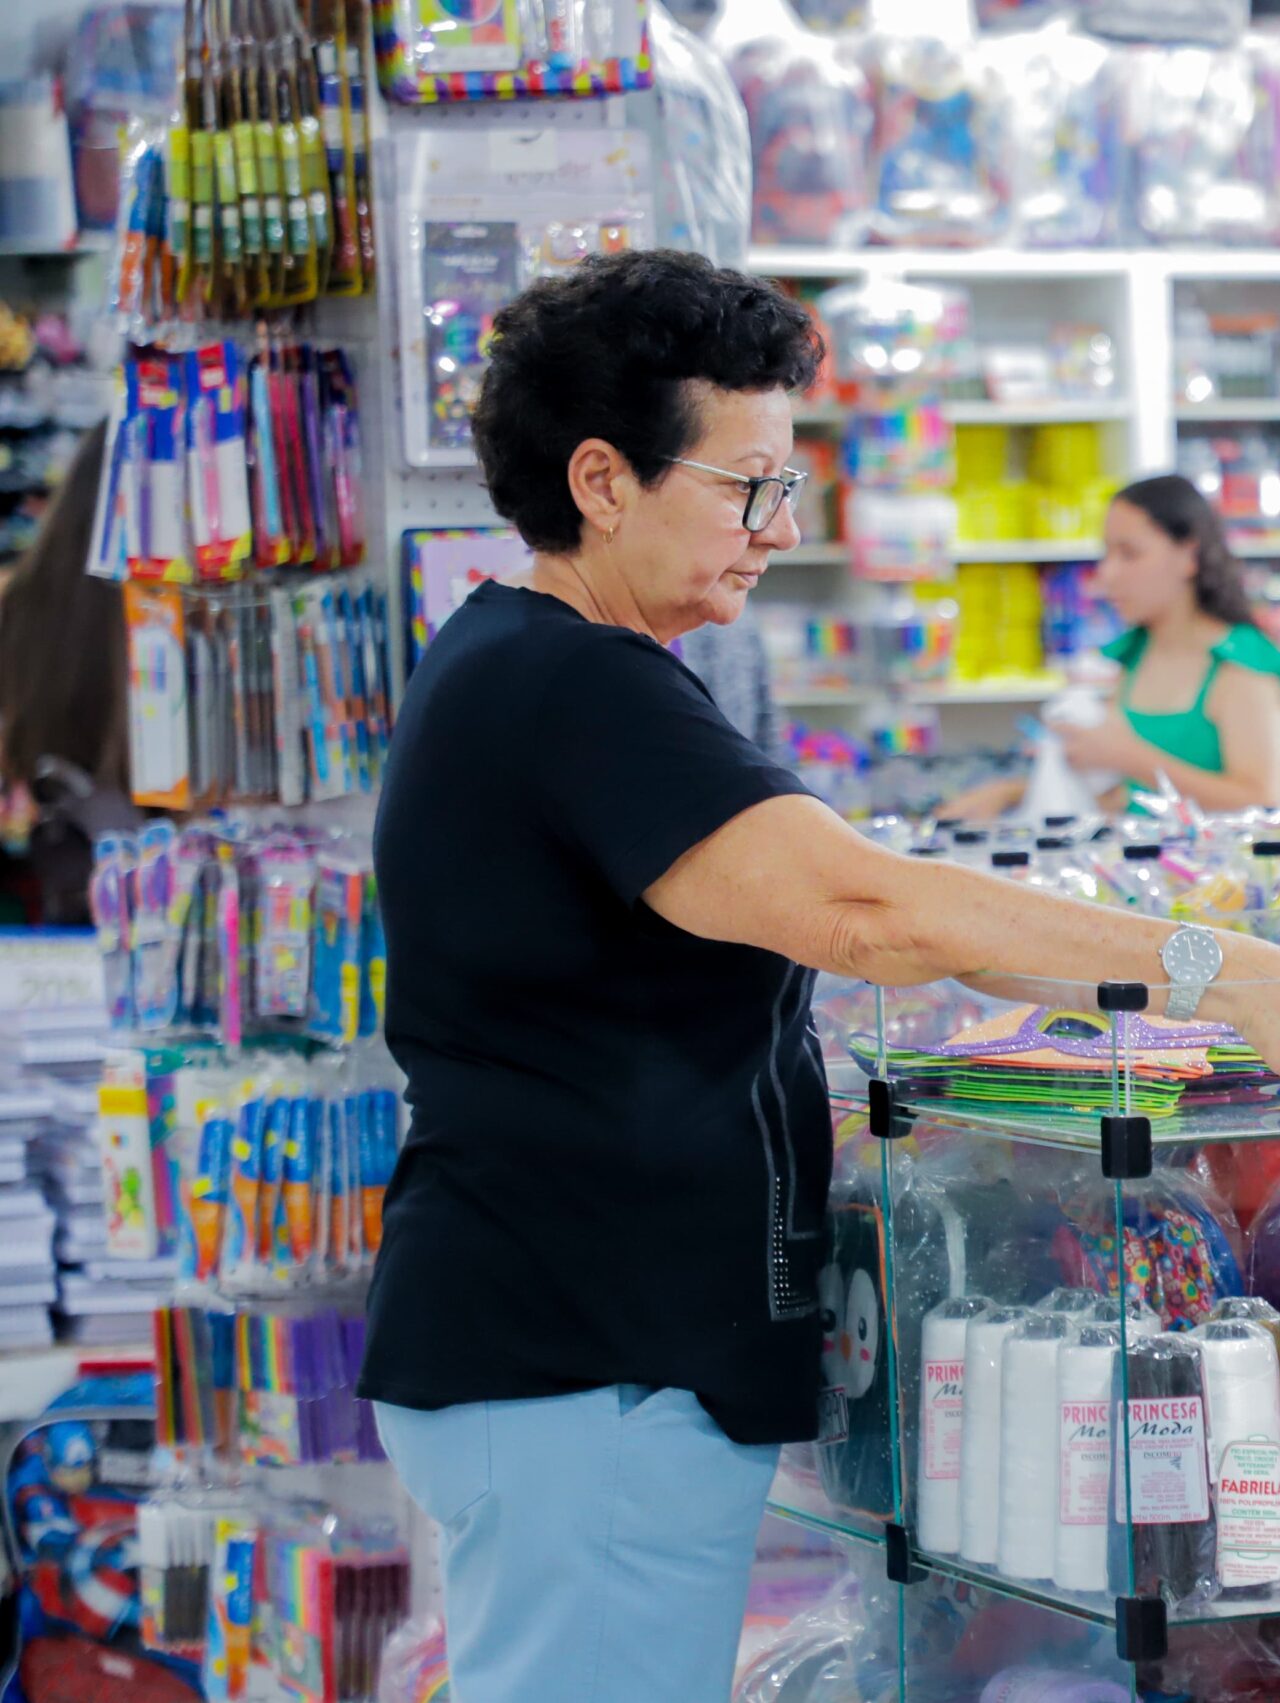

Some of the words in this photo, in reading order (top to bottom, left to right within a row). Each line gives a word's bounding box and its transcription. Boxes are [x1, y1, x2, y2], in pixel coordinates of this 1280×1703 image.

[927, 1364, 964, 1383] PRIN
[1063, 1405, 1107, 1424] PRINC
[1069, 1424, 1107, 1441] Mo
[1130, 1421, 1193, 1440] Moda
